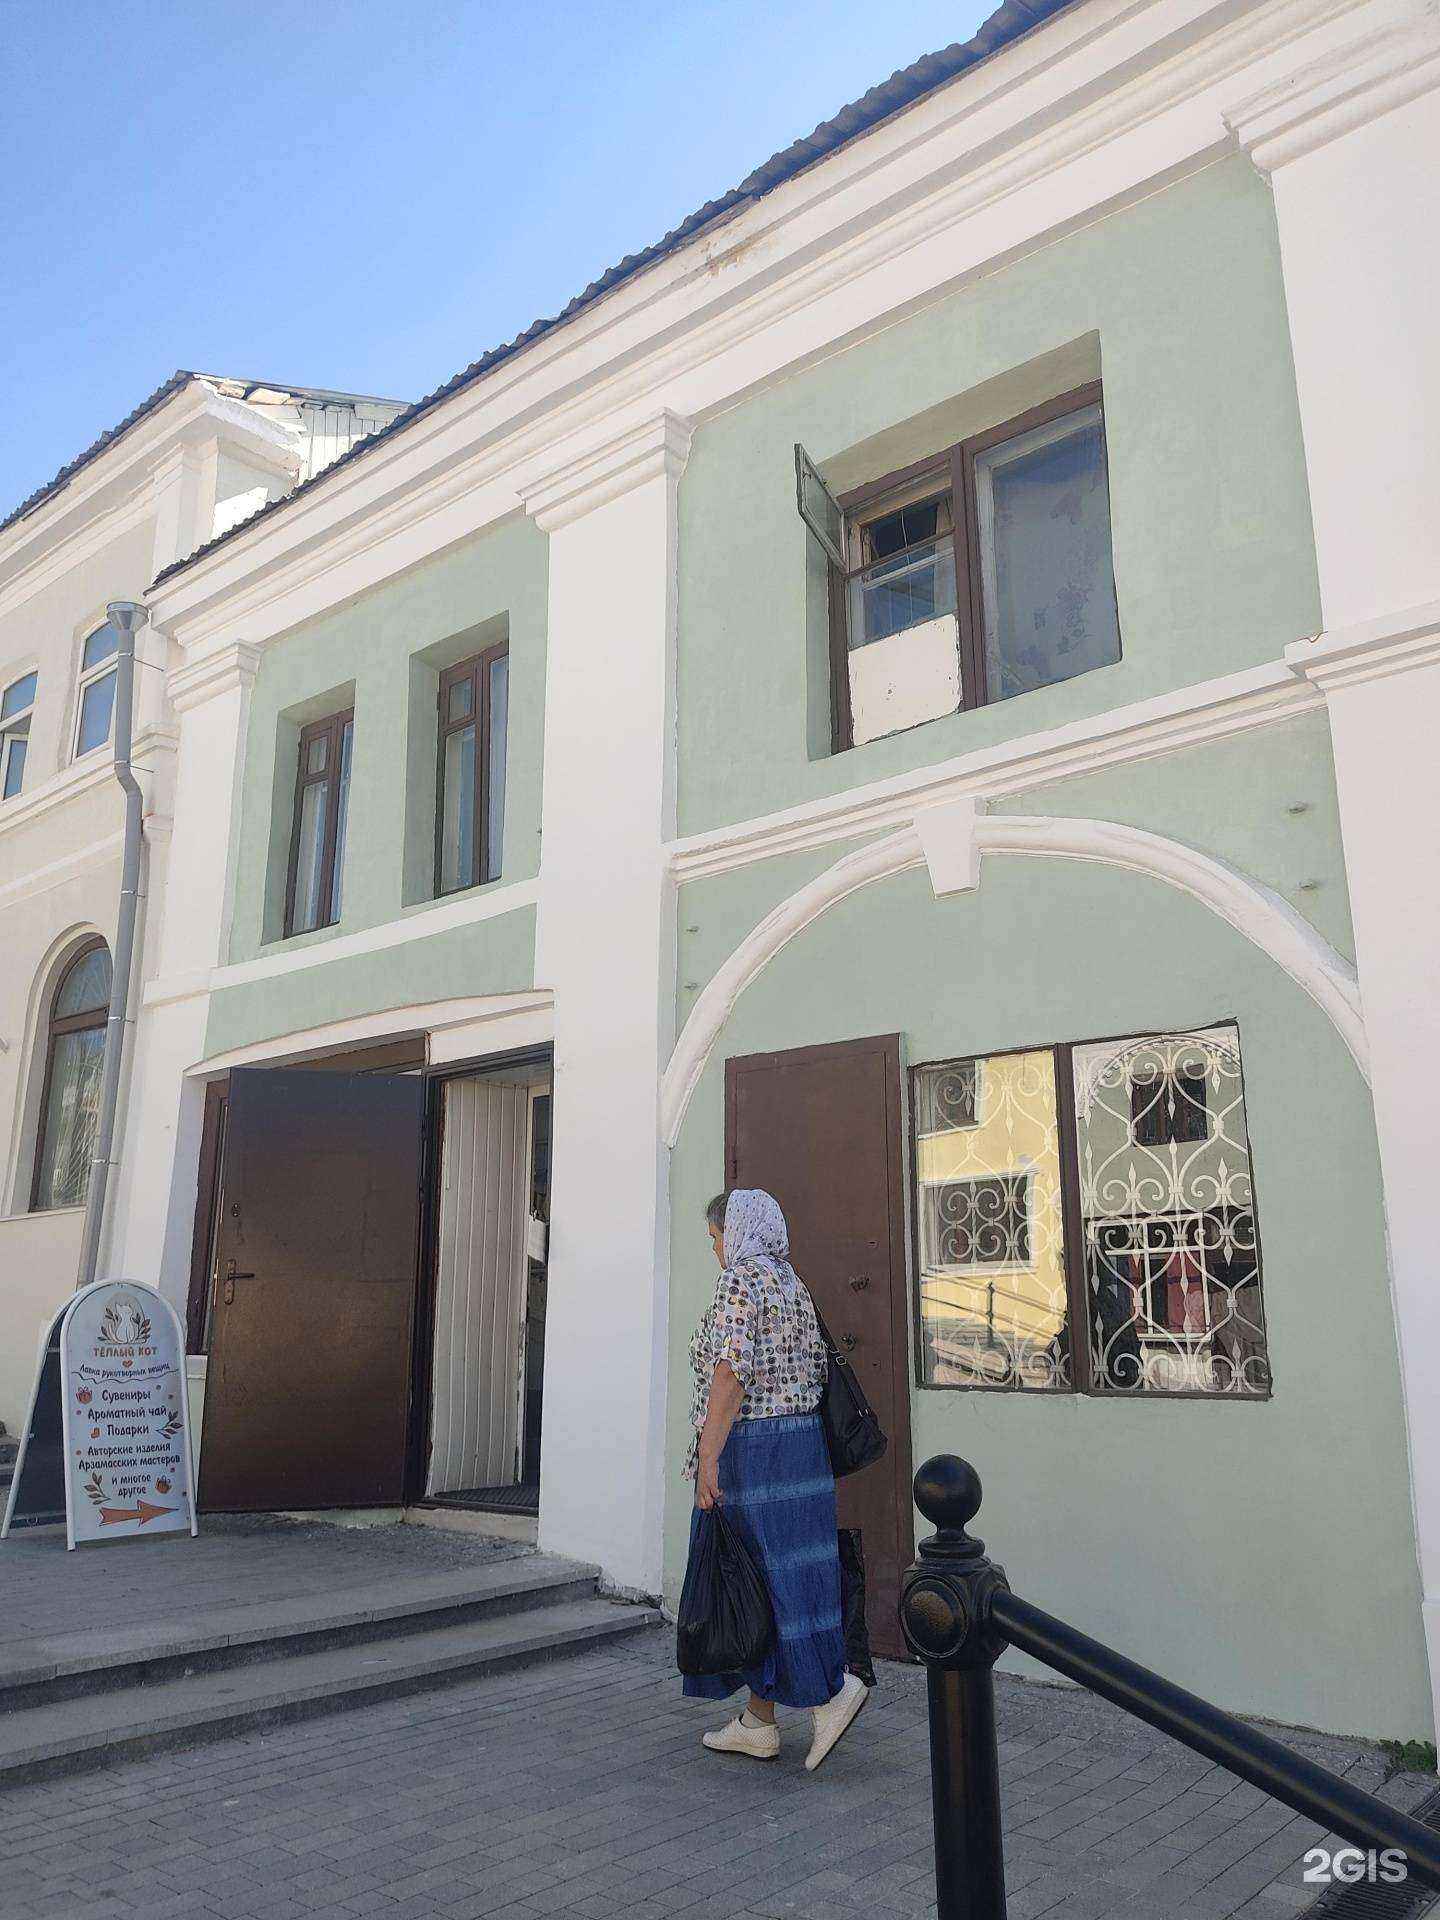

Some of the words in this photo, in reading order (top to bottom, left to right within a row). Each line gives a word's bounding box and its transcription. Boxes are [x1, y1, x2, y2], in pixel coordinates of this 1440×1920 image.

[138, 1346, 158, 1356] КОТ
[101, 1389, 151, 1404] Сувениры
[88, 1406, 146, 1422] Ароматный
[149, 1405, 167, 1416] чай
[107, 1424, 150, 1437] Подарки
[87, 1446, 133, 1457] Авторские
[136, 1442, 171, 1453] изделия
[78, 1459, 137, 1472] Арзамасских
[139, 1456, 181, 1467] мастеров
[120, 1474, 151, 1484] многое
[117, 1486, 147, 1498] другое
